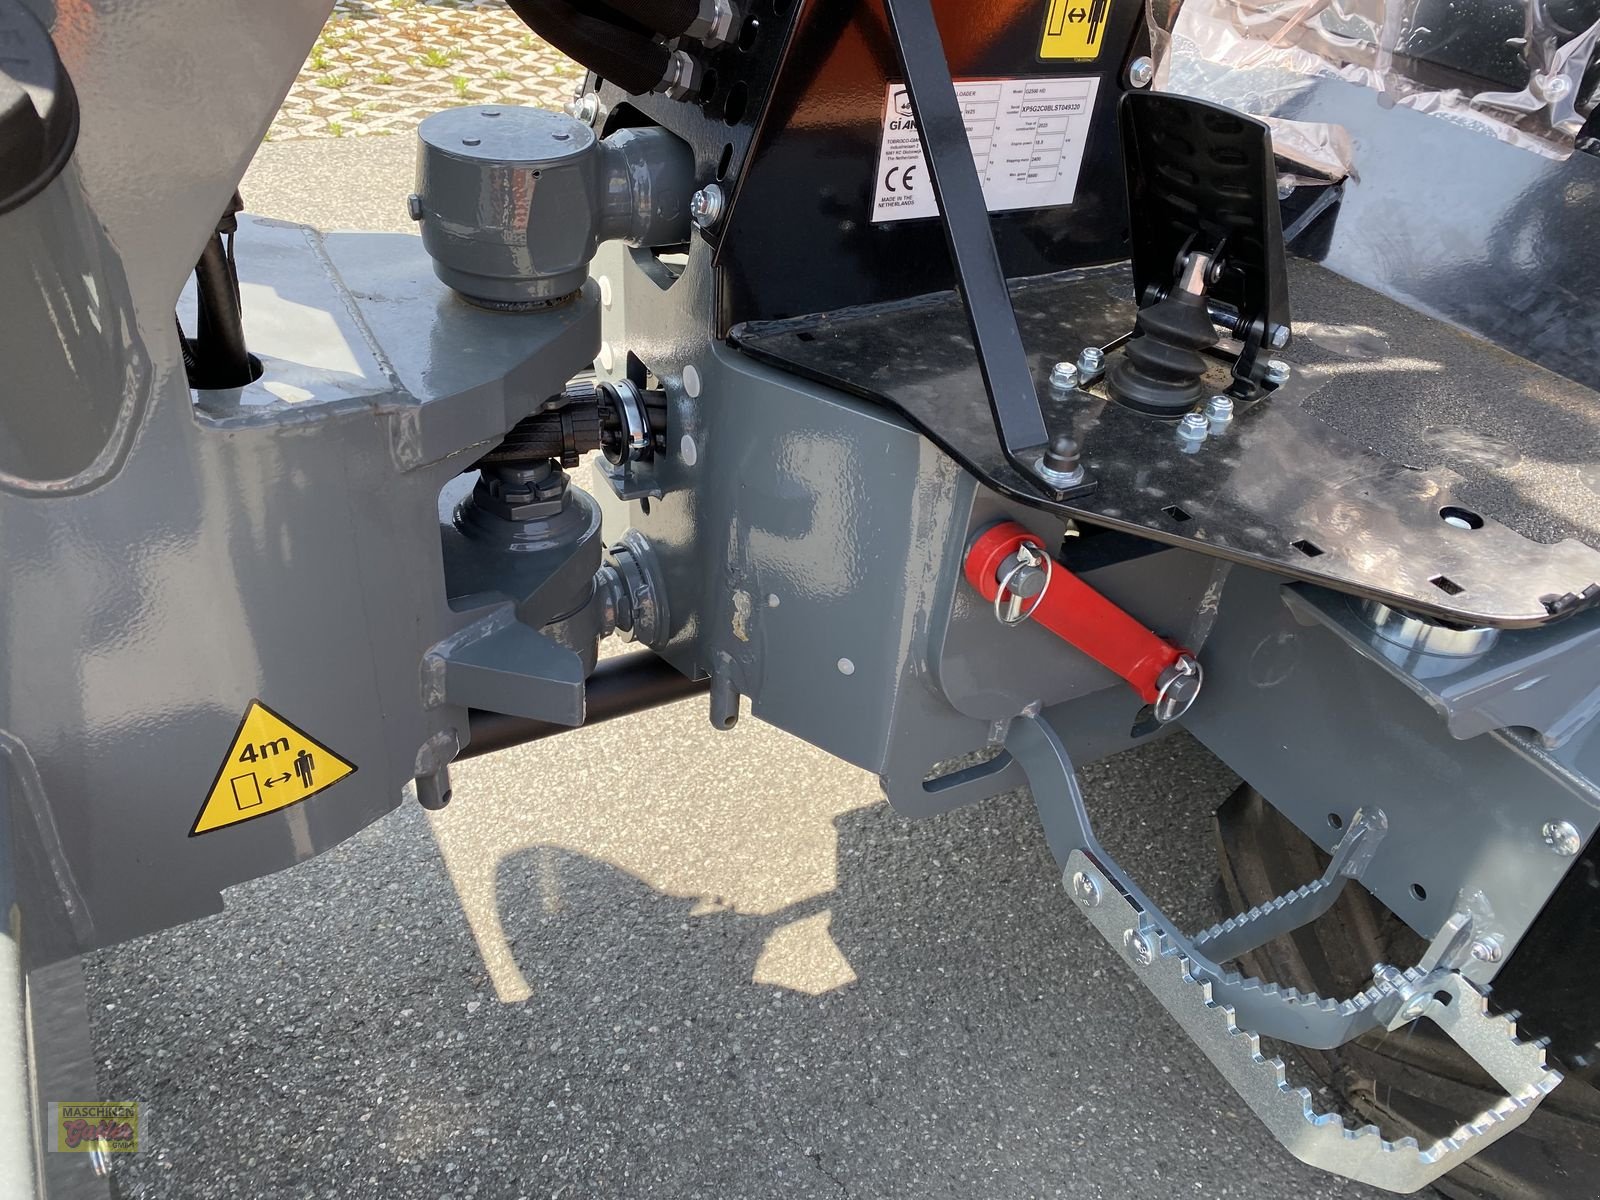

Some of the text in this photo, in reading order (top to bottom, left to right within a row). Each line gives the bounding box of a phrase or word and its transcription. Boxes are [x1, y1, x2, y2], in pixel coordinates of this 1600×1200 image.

[885, 165, 916, 192] CE
[878, 200, 915, 208] NETHERLANDS
[239, 737, 290, 763] 4m
